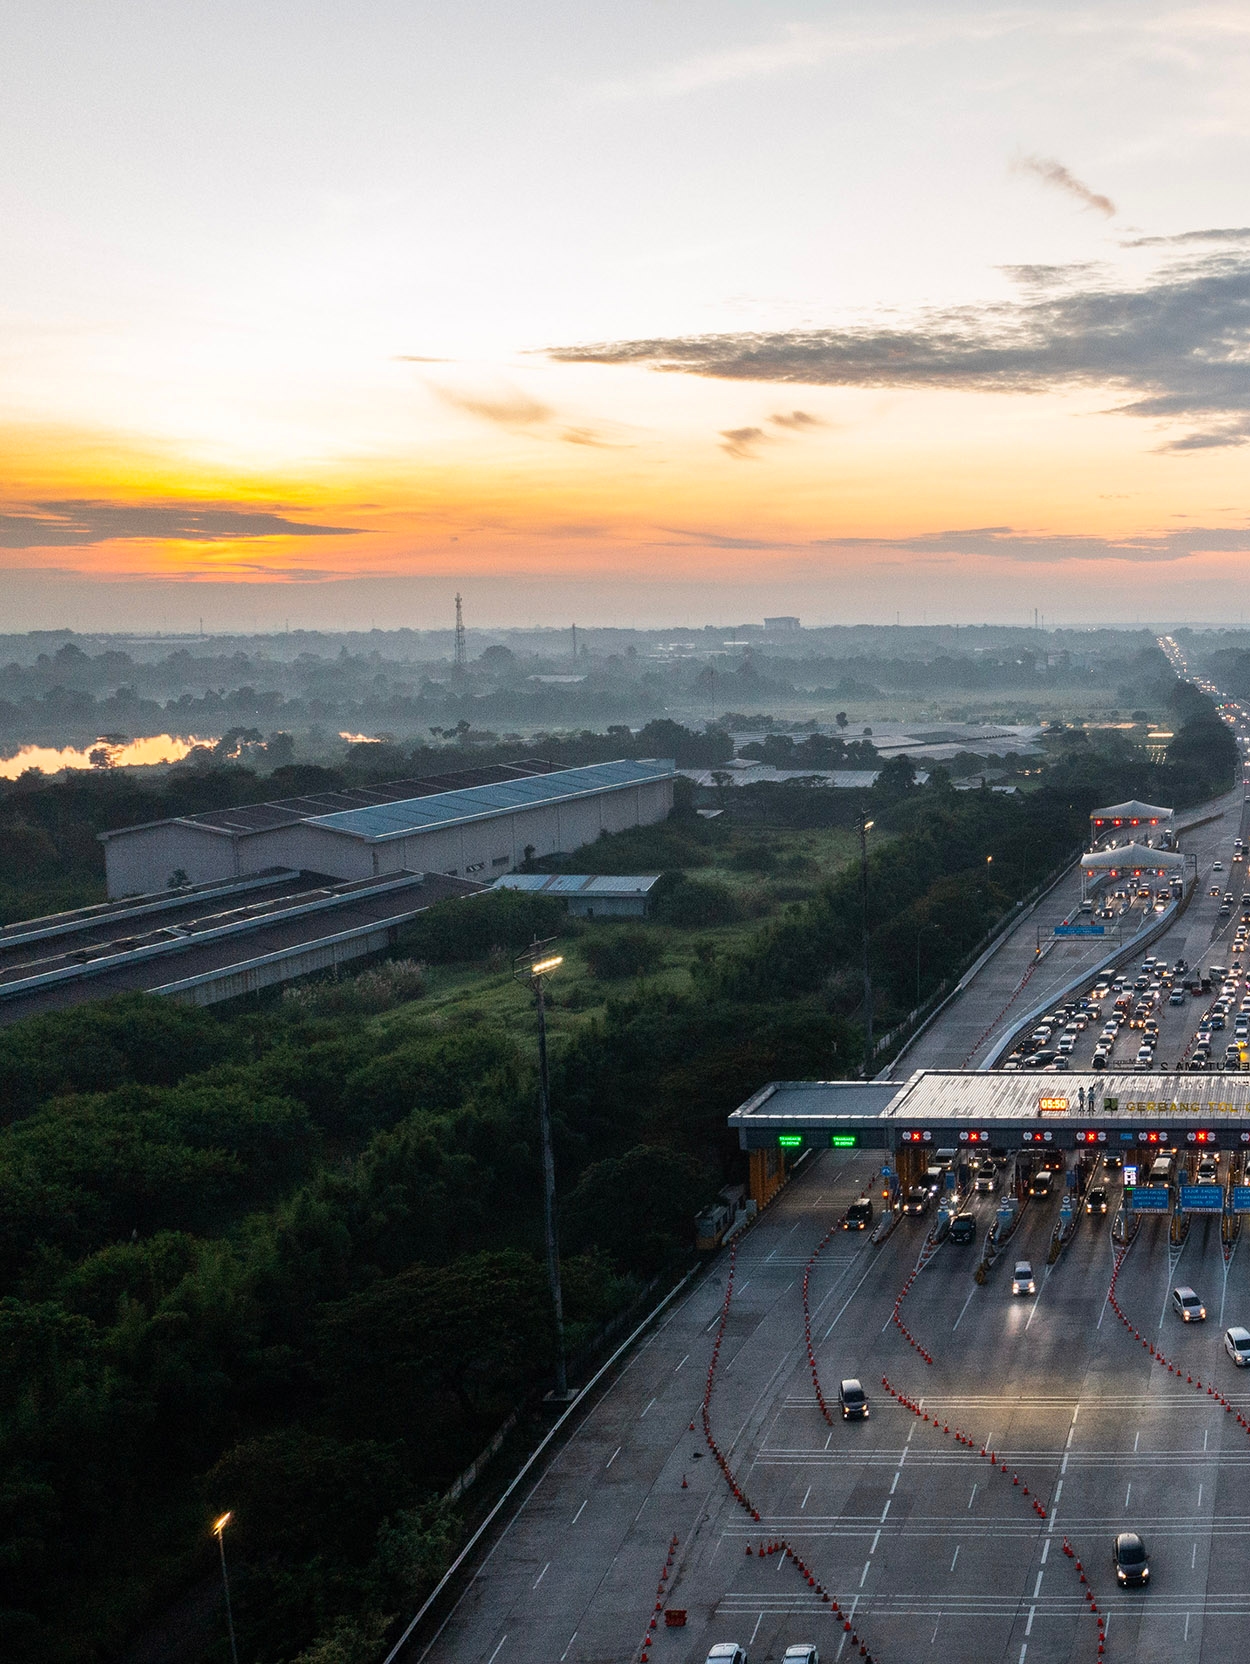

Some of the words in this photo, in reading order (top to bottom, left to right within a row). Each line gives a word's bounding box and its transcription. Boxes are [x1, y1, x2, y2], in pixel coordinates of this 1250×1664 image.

[1041, 1099, 1066, 1109] 05:50
[1126, 1101, 1200, 1112] GERBANG
[1208, 1101, 1238, 1112] TOL
